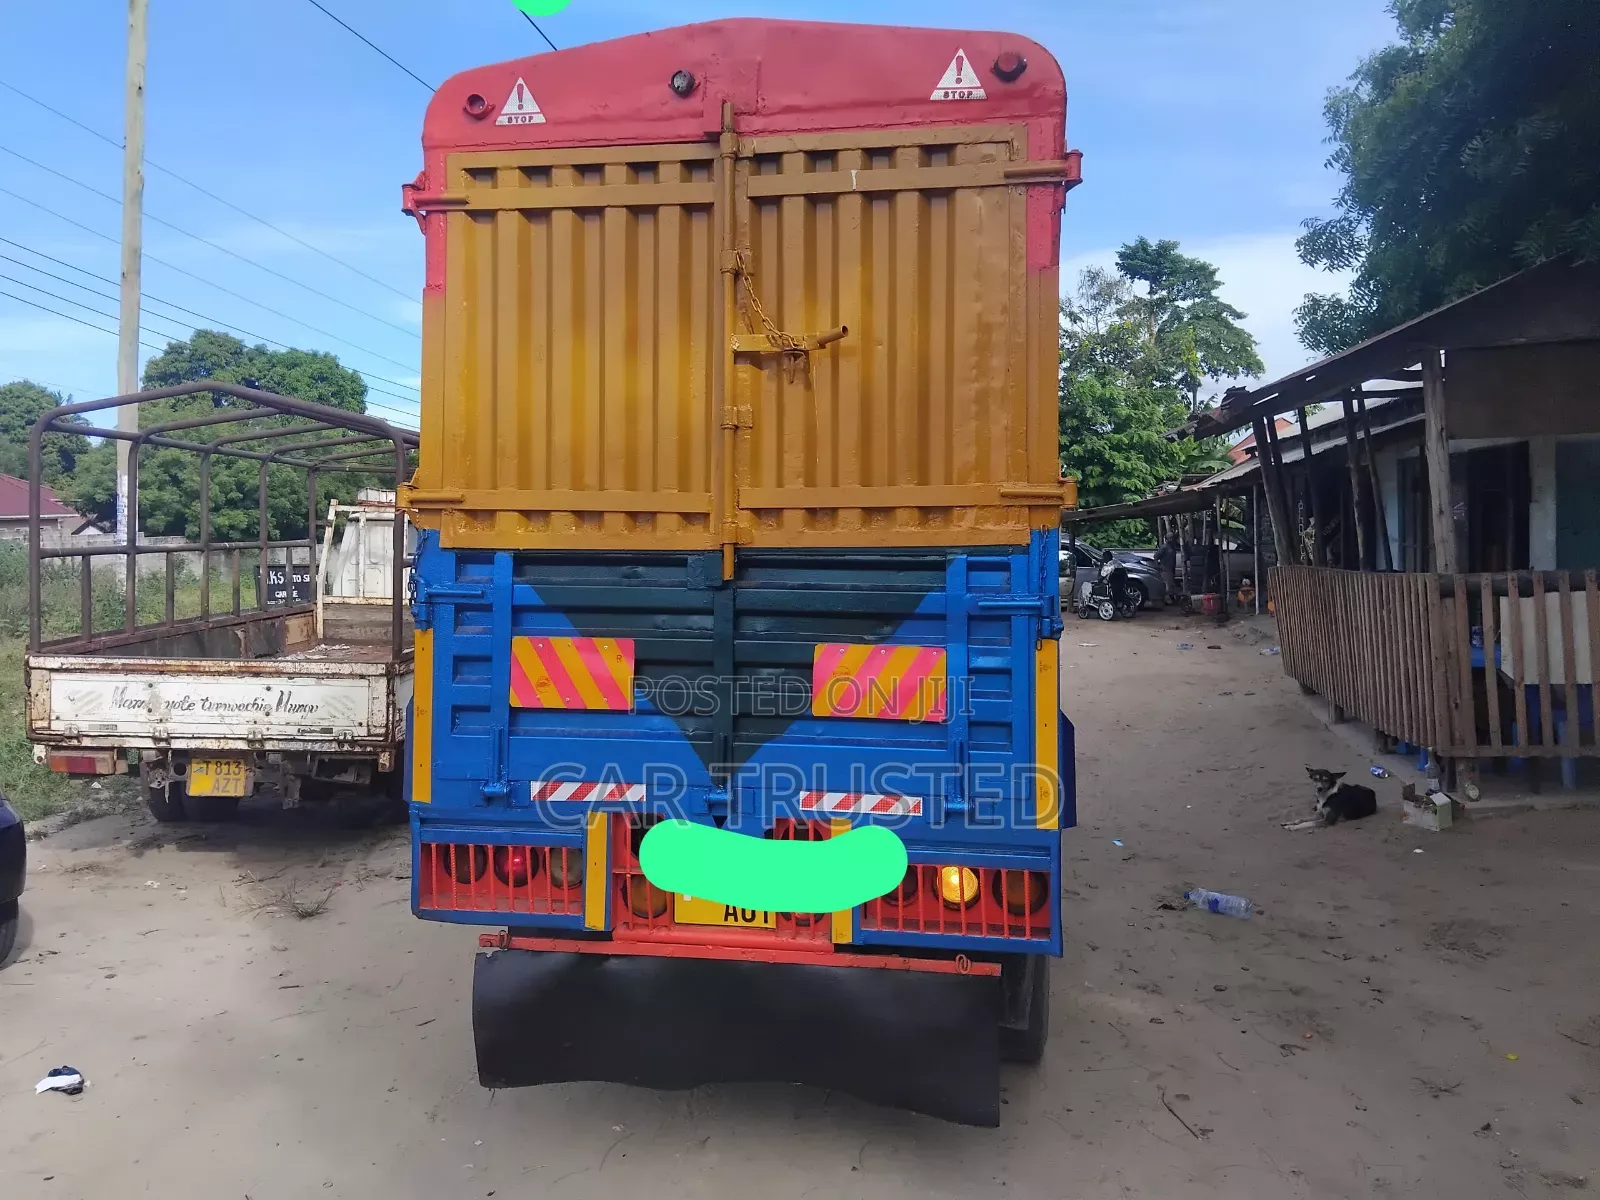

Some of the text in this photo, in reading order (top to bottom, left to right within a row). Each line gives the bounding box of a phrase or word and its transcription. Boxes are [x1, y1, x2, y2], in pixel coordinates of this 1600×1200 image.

[943, 90, 973, 99] STOP
[507, 116, 534, 124] STOP
[203, 760, 242, 776] T 813
[212, 777, 242, 793] AZT
